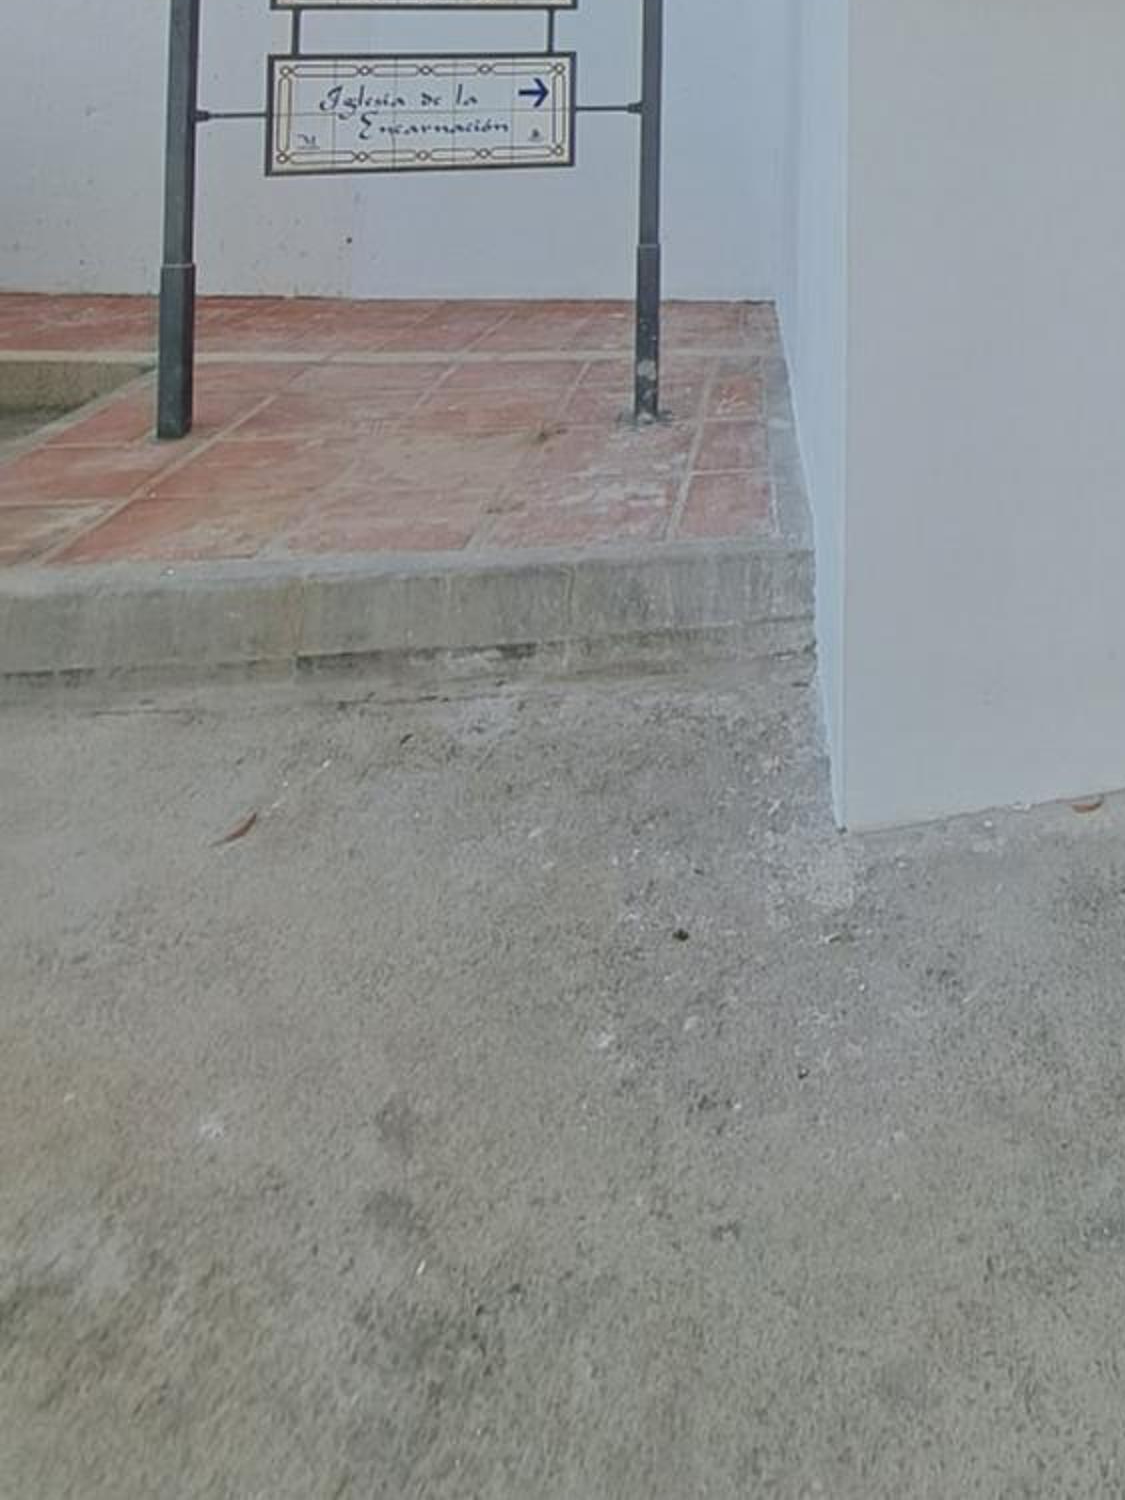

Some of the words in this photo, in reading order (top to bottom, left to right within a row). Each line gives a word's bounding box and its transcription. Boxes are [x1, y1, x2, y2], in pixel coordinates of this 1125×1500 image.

[318, 85, 405, 120] Iglesia
[420, 91, 441, 106] de
[456, 83, 479, 106] la
[358, 110, 509, 140] Encarnación
